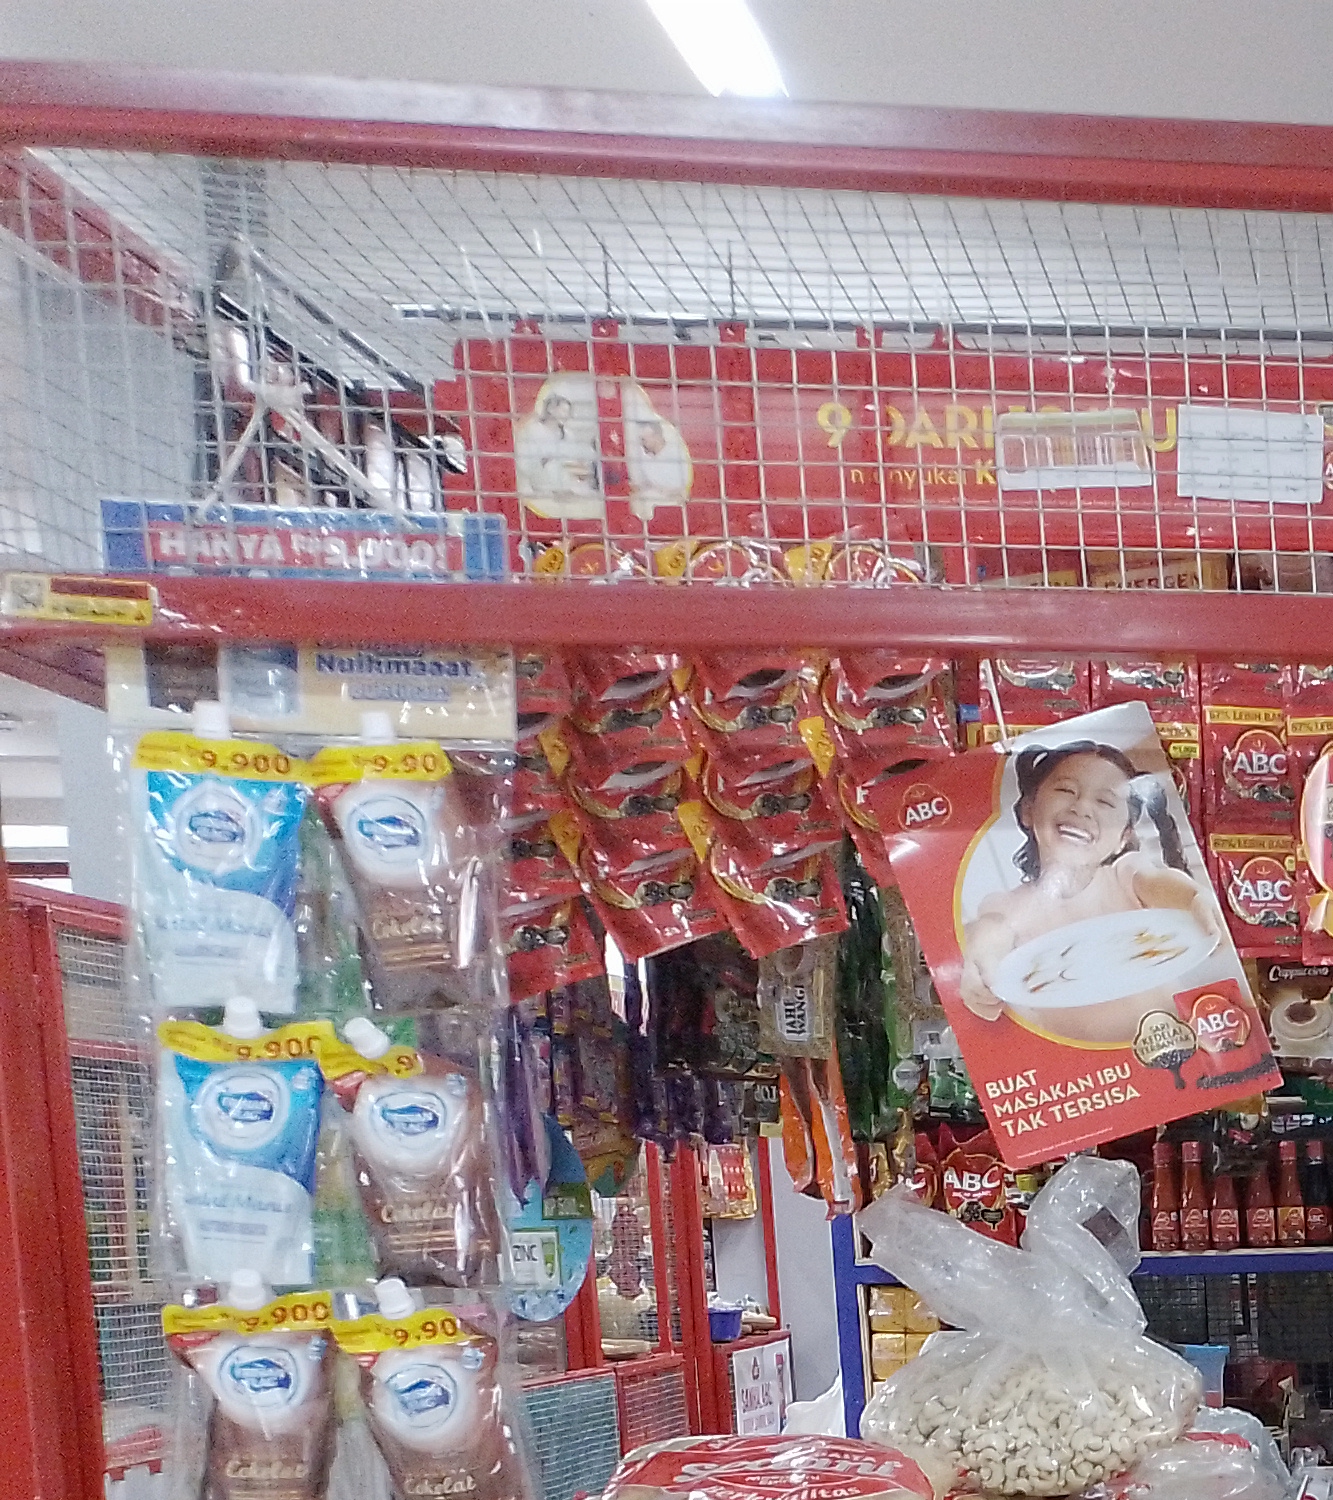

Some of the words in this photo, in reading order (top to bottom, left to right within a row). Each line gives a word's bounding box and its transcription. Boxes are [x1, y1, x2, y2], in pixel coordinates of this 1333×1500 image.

[985, 1069, 1038, 1099] BUAT
[992, 1075, 1094, 1118] MASAKAN
[1048, 1083, 1141, 1123] TERSISA
[943, 1166, 1001, 1193] ABC
